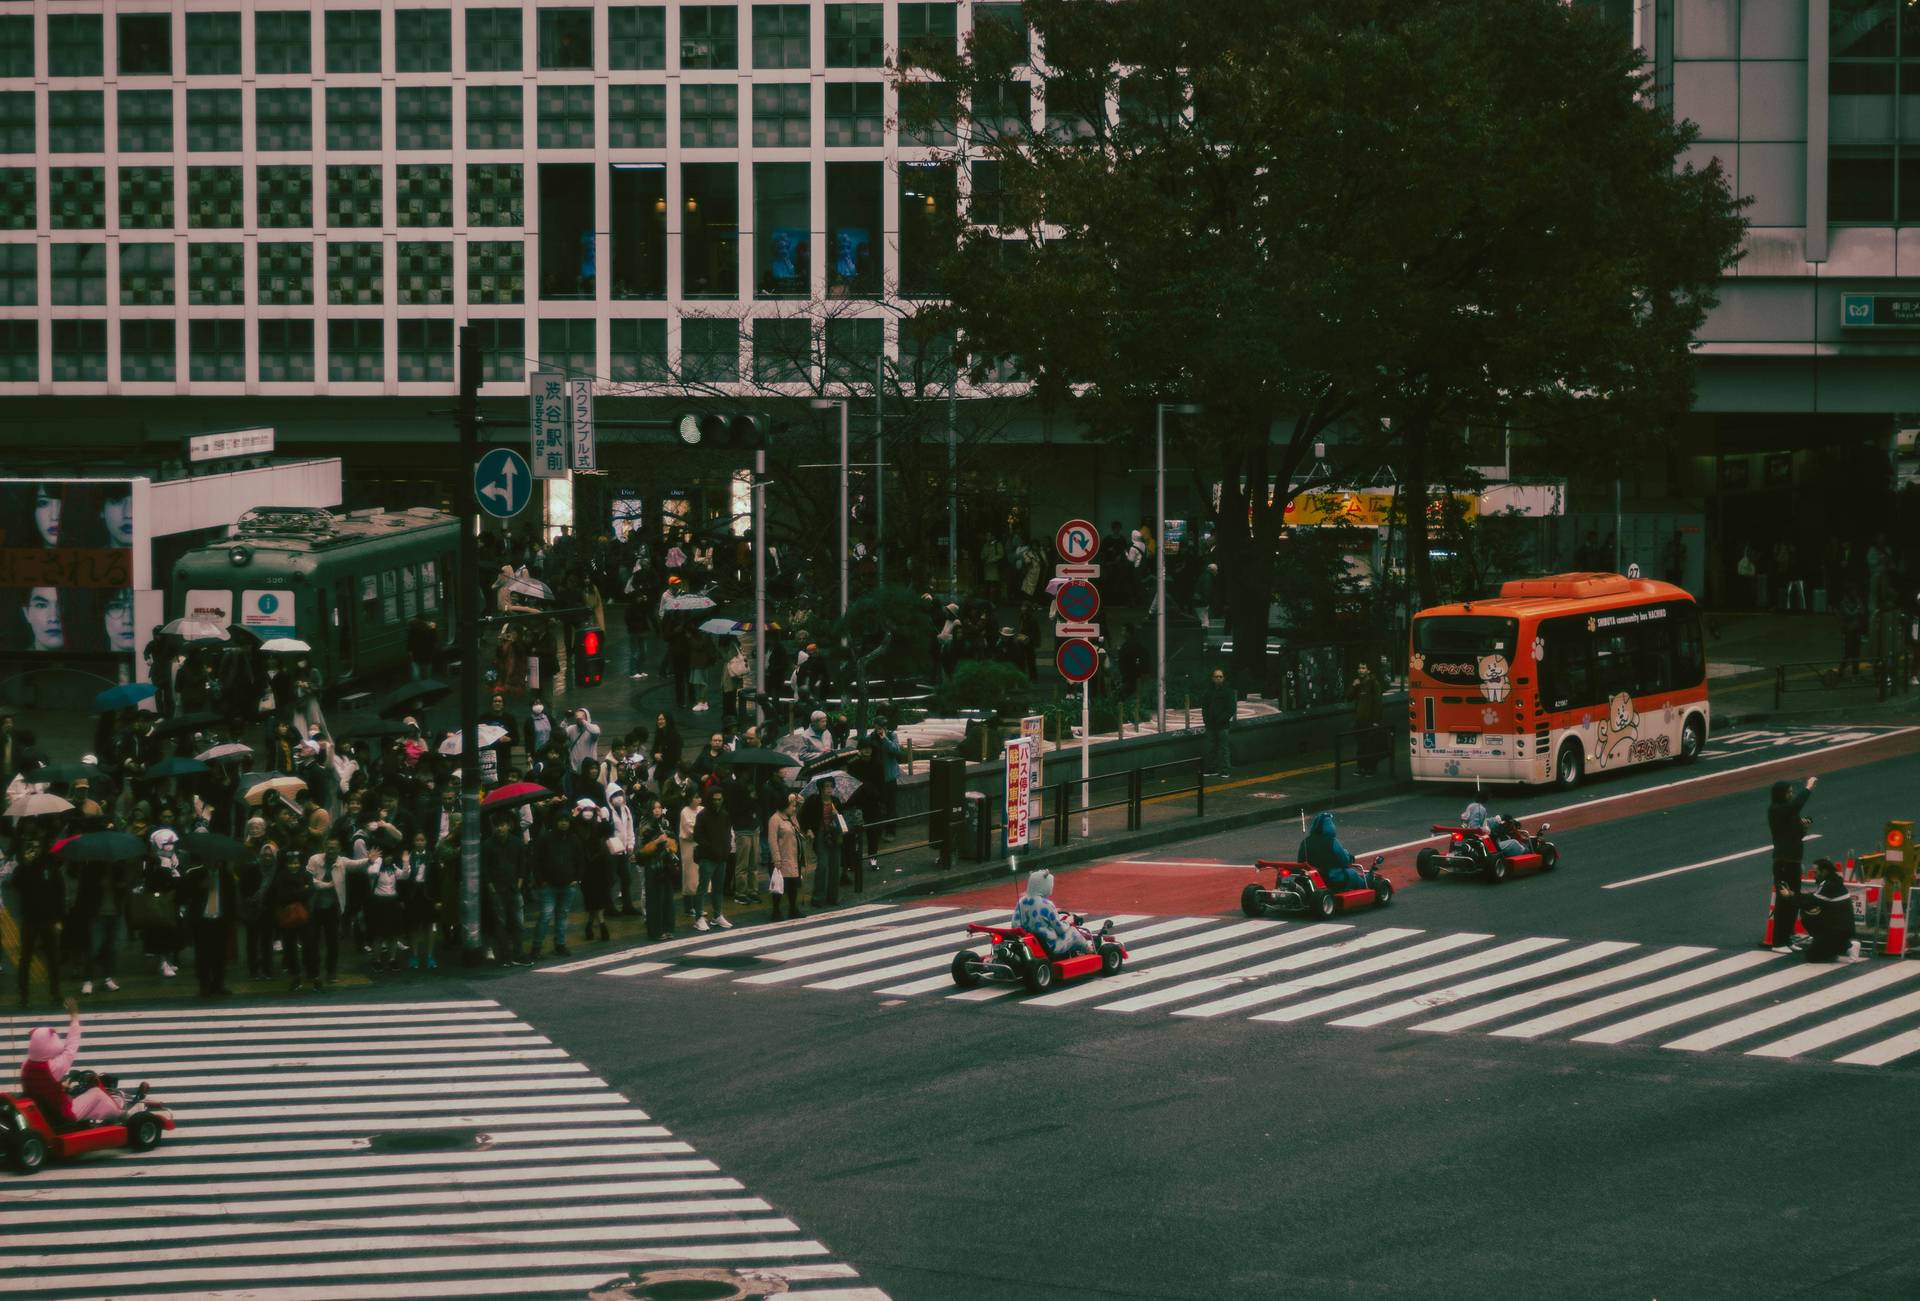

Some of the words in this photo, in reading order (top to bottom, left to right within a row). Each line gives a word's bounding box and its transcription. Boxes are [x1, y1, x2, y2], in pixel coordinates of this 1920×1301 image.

[534, 395, 544, 436] Shibuya
[546, 382, 562, 470] 渋谷駅前
[576, 382, 591, 467] スクランブル式
[1019, 747, 1028, 838] バス停につき
